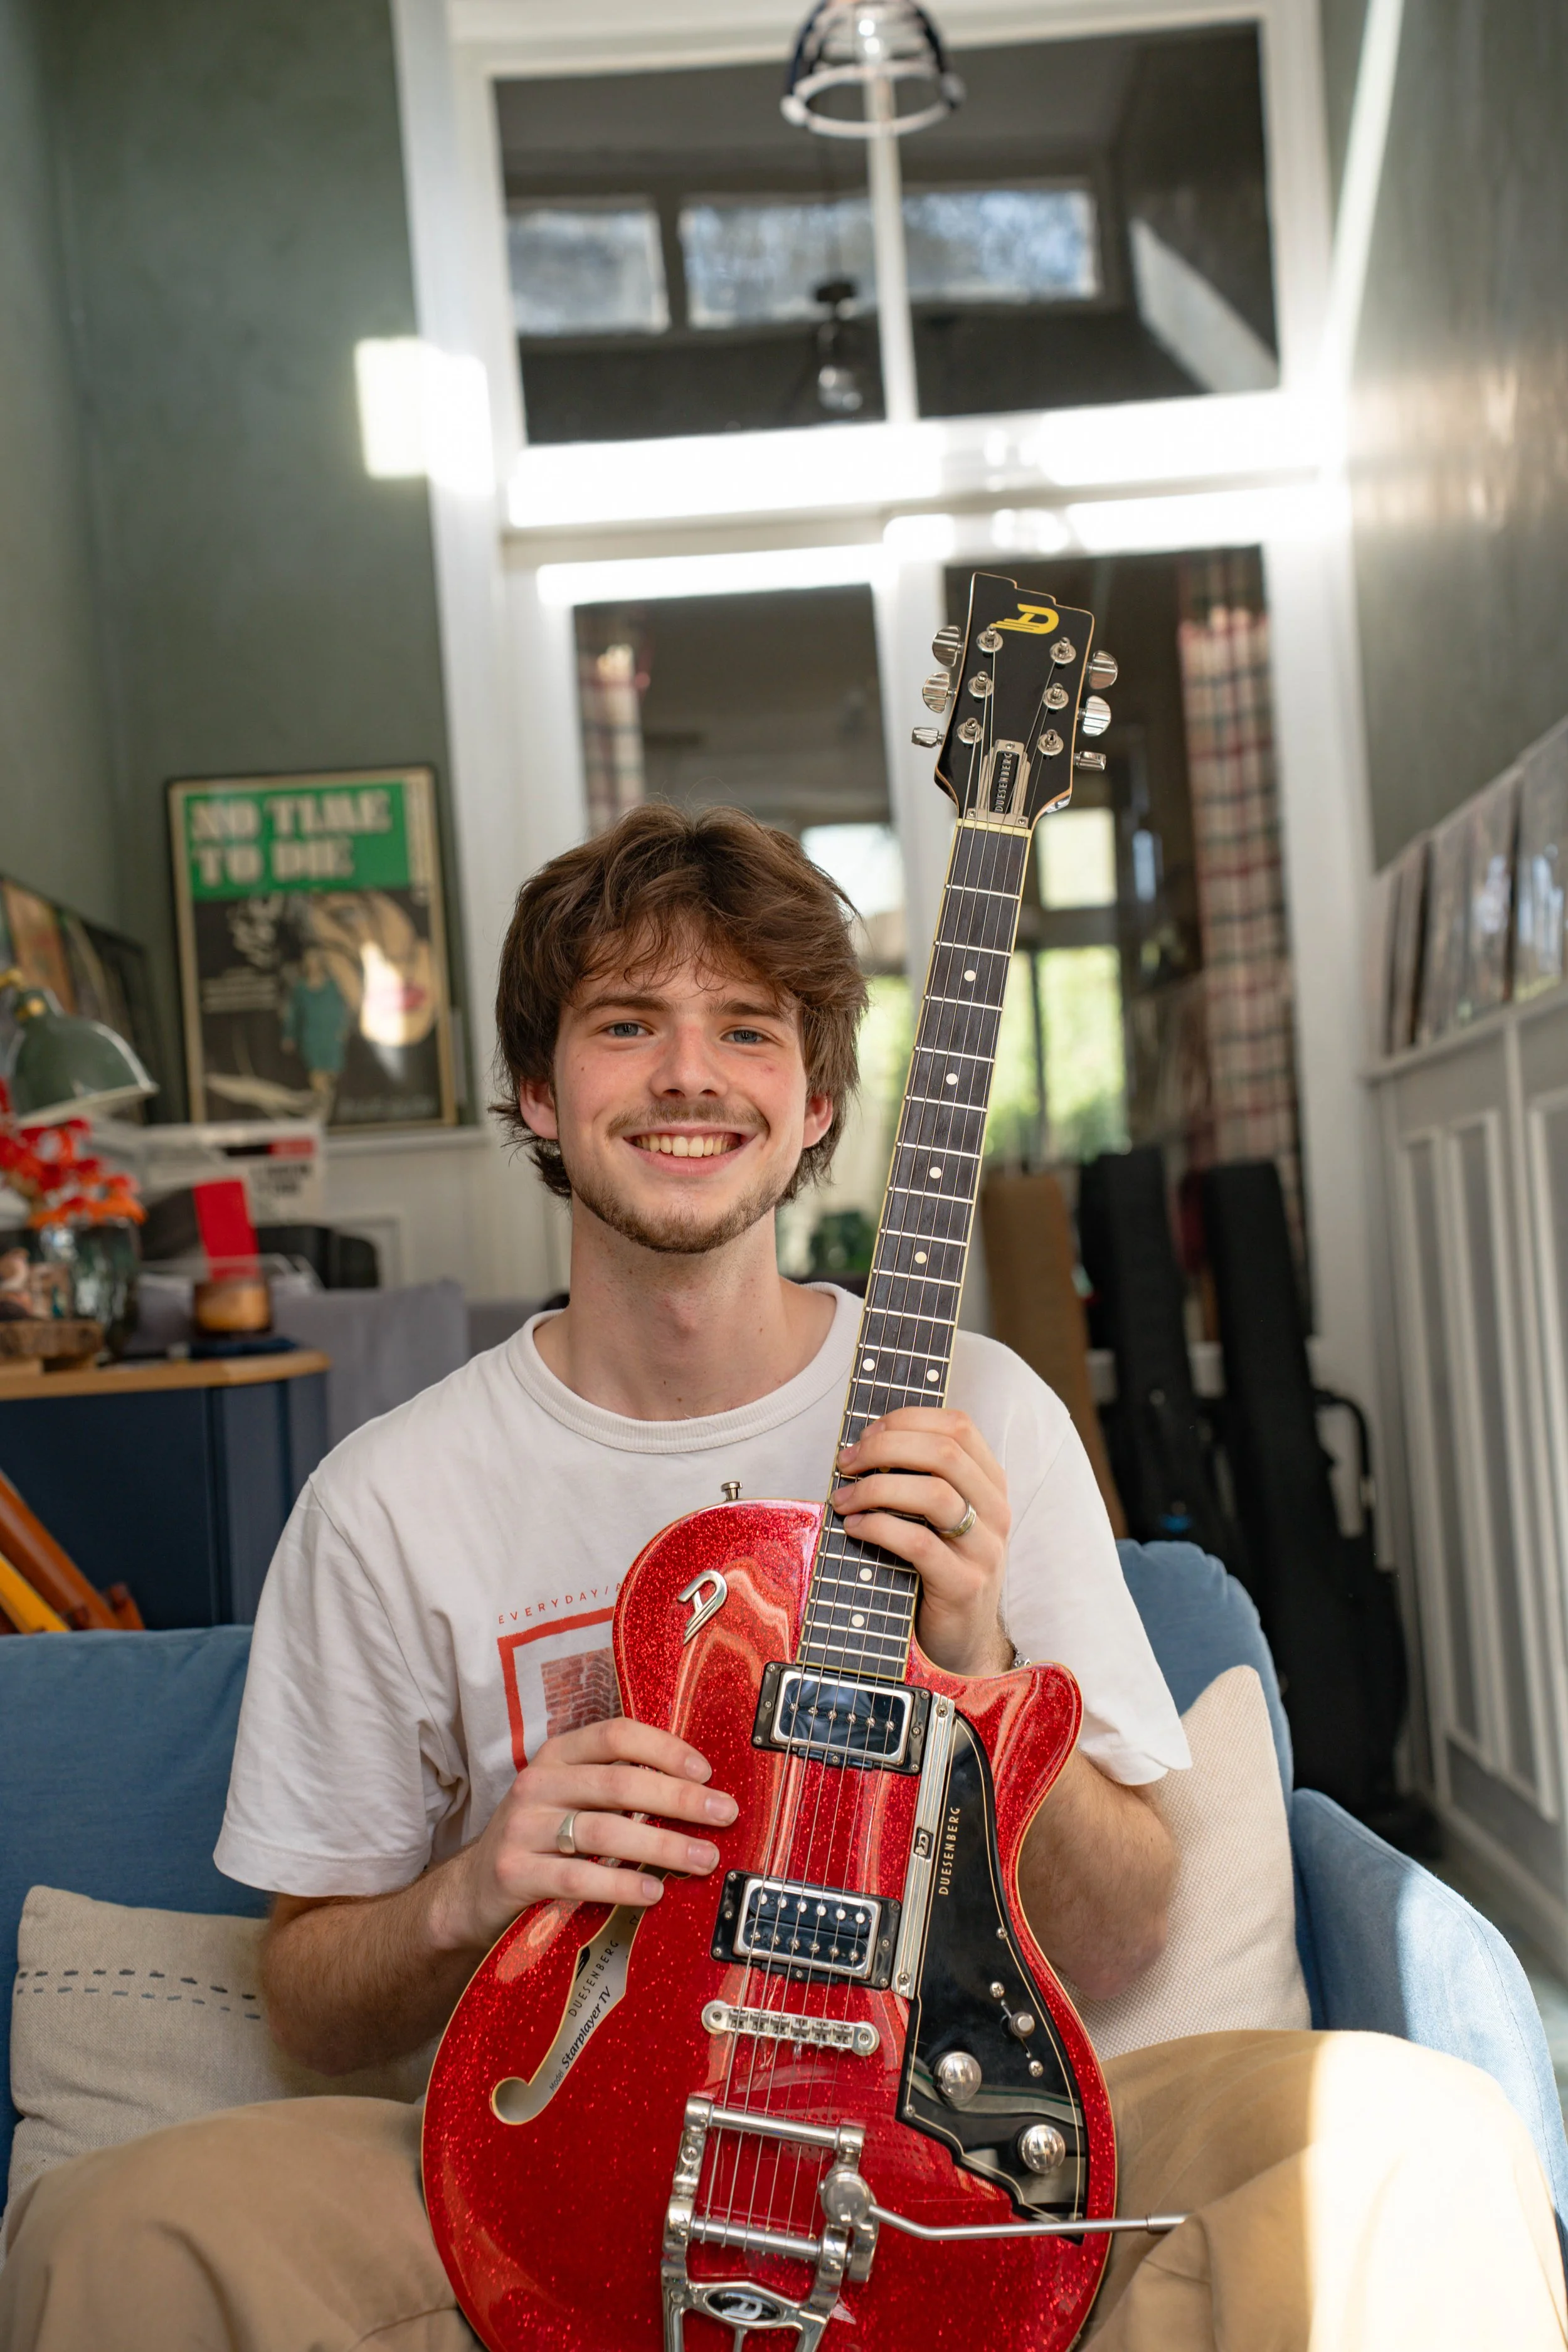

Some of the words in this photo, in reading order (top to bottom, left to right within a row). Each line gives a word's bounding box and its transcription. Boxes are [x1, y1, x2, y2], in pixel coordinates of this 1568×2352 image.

[267, 789, 391, 835] TIME
[995, 753, 1013, 813] DUESENBERG
[193, 844, 263, 885] TO
[938, 1807, 960, 1895] DUESENBERG
[568, 1940, 619, 2017] DUESENBERG
[549, 2070, 564, 2091] Model
[561, 2003, 601, 2069] Starplayer
[599, 1986, 612, 2004] TV
